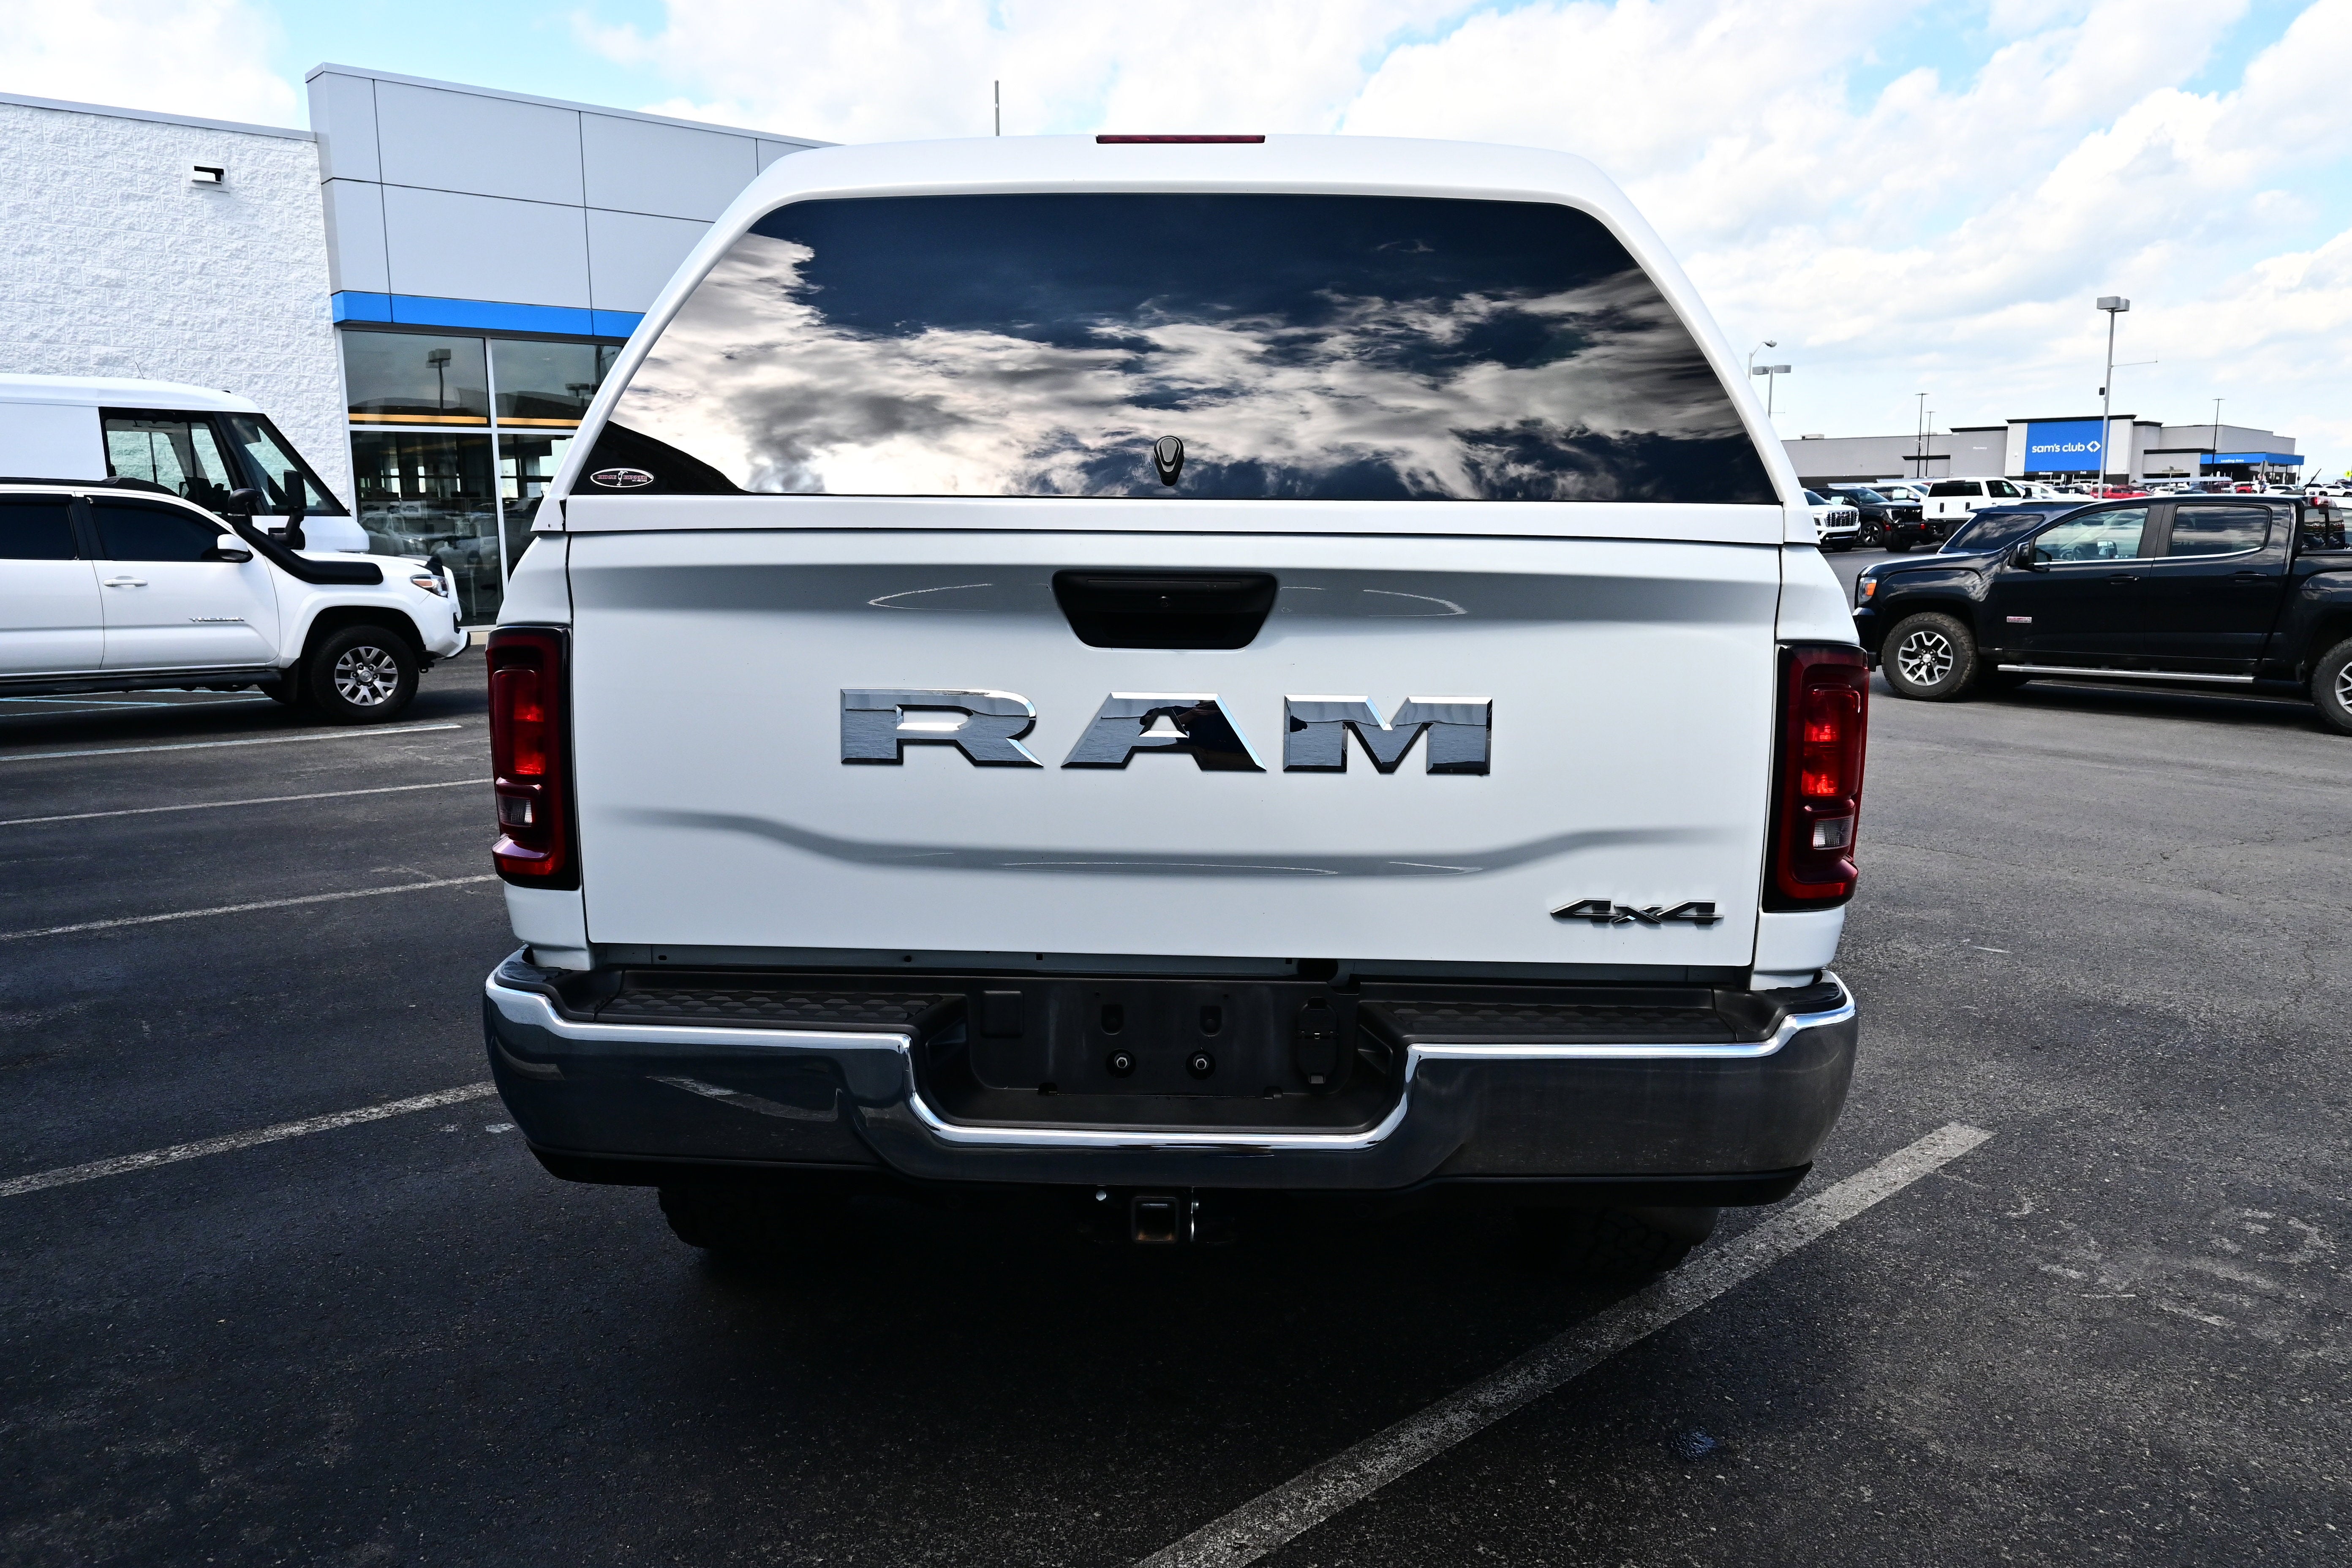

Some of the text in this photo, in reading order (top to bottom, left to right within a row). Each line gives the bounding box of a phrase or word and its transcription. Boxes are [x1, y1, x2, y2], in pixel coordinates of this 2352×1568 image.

[2032, 442, 2085, 453] sam's club
[840, 687, 1493, 774] RAM
